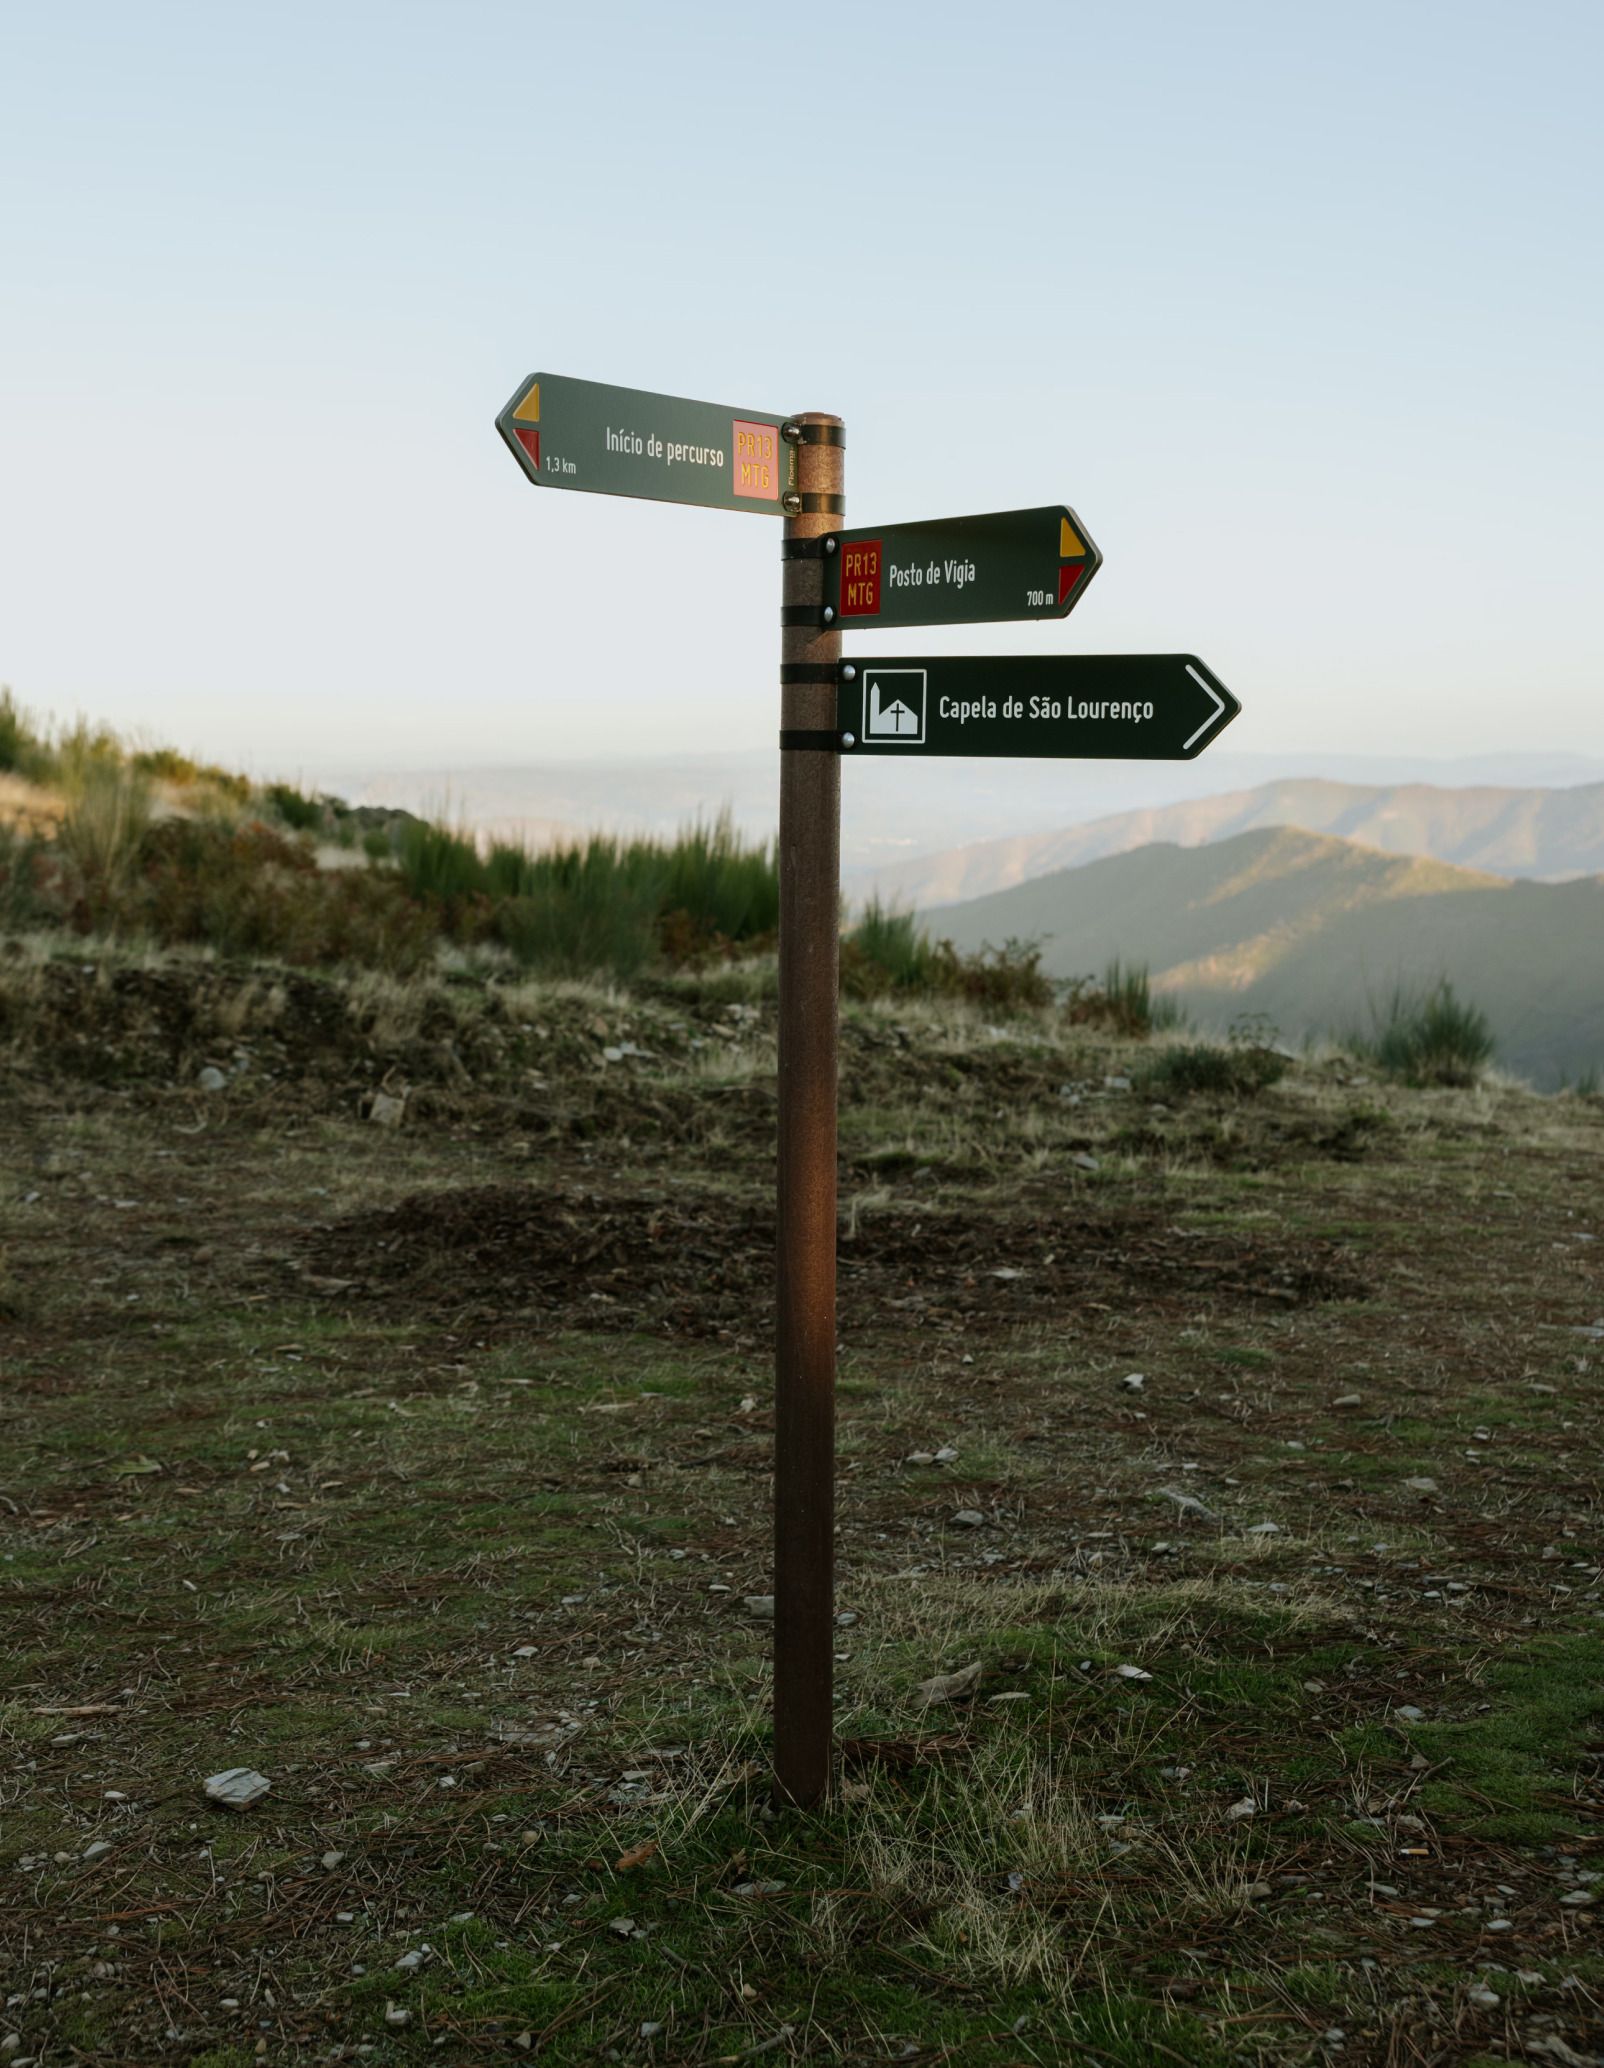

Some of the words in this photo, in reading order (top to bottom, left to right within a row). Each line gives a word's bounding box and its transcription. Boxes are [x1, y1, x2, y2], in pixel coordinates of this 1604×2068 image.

[606, 426, 643, 455] Início
[647, 433, 663, 458] de
[667, 442, 724, 467] percurso
[737, 431, 772, 460] PR13
[546, 456, 560, 473] 1,3
[562, 457, 577, 475] km
[741, 463, 769, 488] MTG
[846, 552, 877, 577] PR13
[889, 562, 923, 588] Posto
[926, 561, 941, 585] de
[944, 559, 976, 589] Vigia
[848, 582, 874, 606] MTG
[1026, 590, 1044, 606] 700
[1045, 593, 1054, 606] m
[939, 695, 997, 725] Capela
[1002, 695, 1024, 719] de
[1029, 695, 1062, 719] São
[1067, 695, 1154, 724] Lourenço
